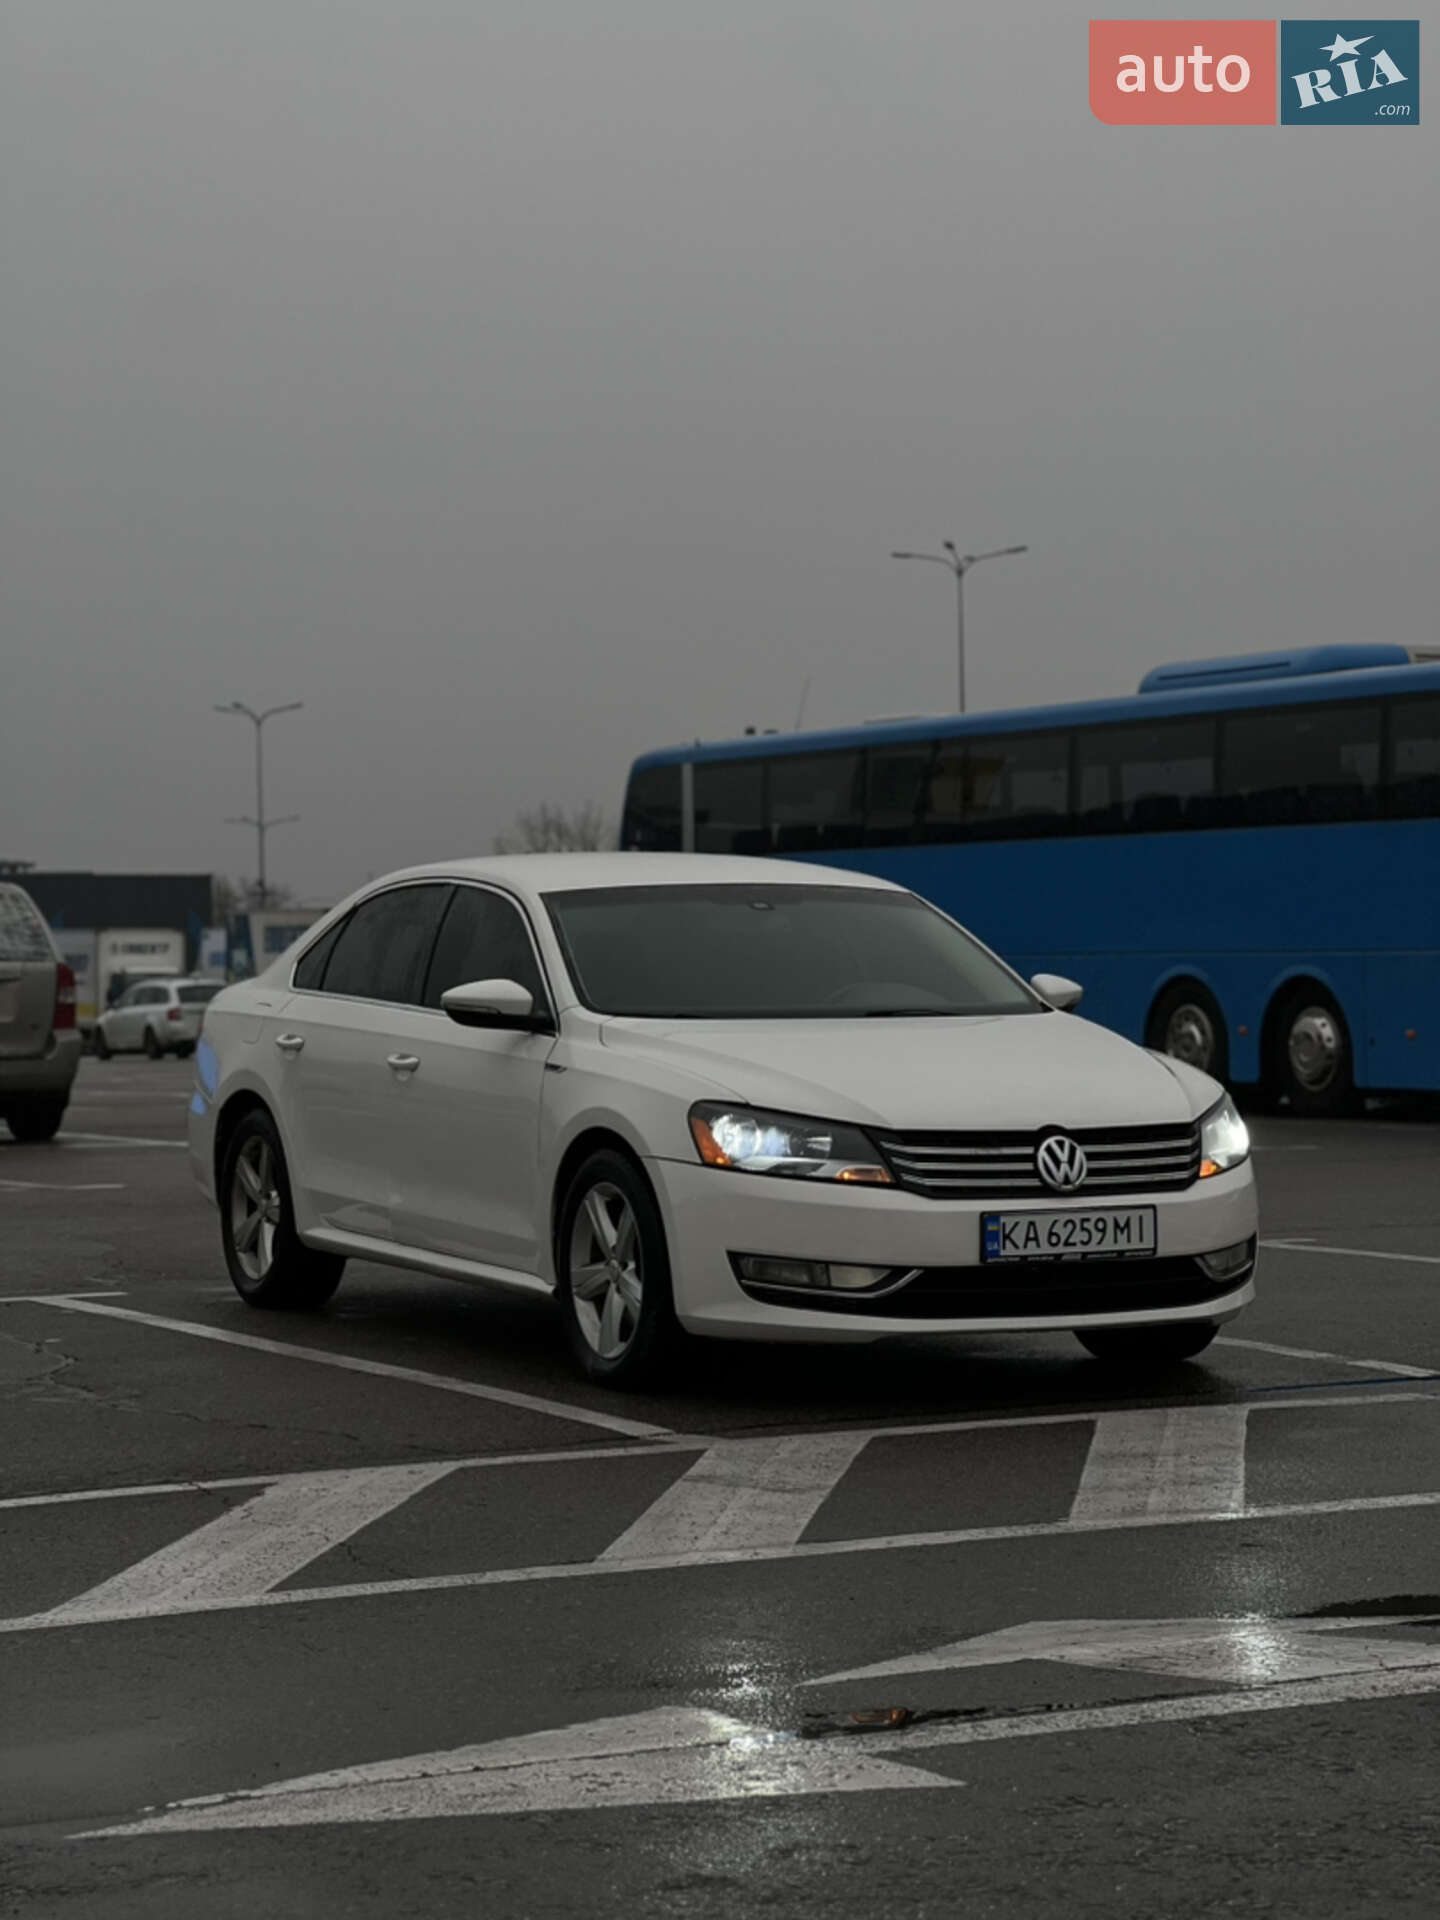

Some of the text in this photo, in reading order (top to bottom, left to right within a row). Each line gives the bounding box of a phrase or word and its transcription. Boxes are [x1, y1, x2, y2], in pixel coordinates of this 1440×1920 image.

[1038, 1137, 1086, 1189] VW
[1002, 1214, 1144, 1250] KA 6259 MI
